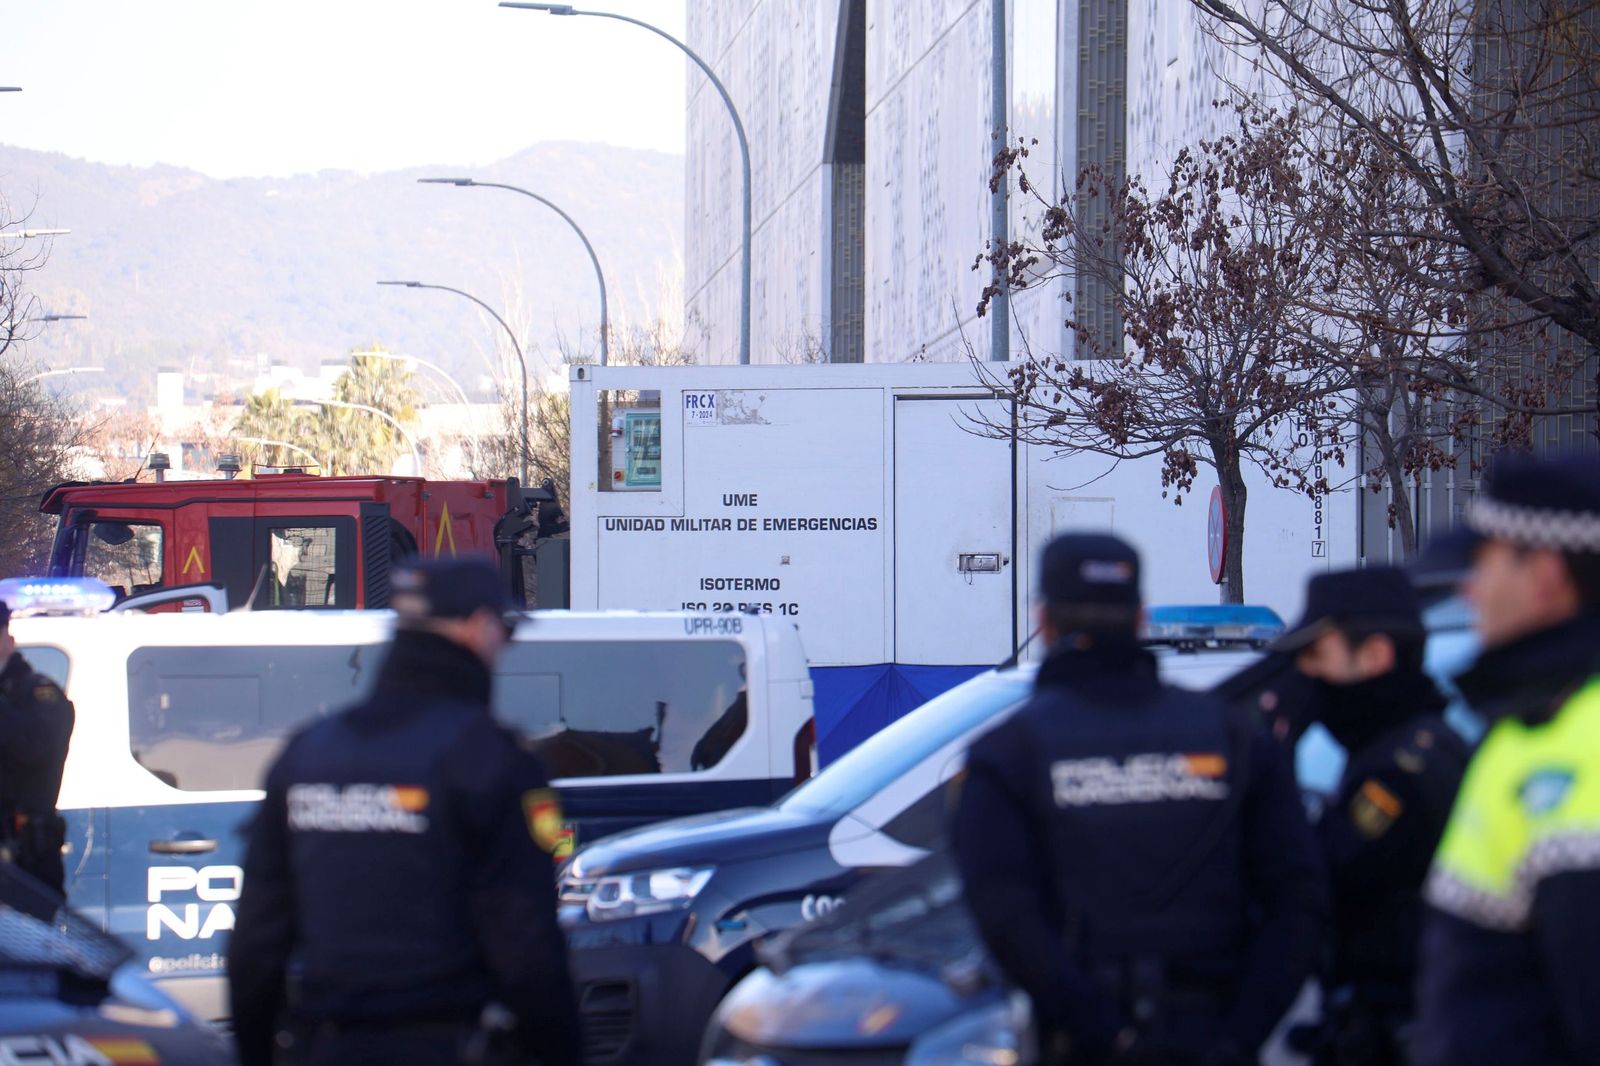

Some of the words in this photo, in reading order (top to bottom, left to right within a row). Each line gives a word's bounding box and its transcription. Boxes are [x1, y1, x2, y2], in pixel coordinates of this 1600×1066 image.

[685, 394, 715, 409] FRCX
[722, 493, 758, 507] UME
[605, 518, 666, 532] UNIDAD
[670, 518, 732, 532] MILITAR
[737, 518, 758, 531] DE
[762, 517, 878, 531] EMERGENCIAS
[699, 577, 781, 591] ISOTERMO
[778, 602, 799, 616] 1C
